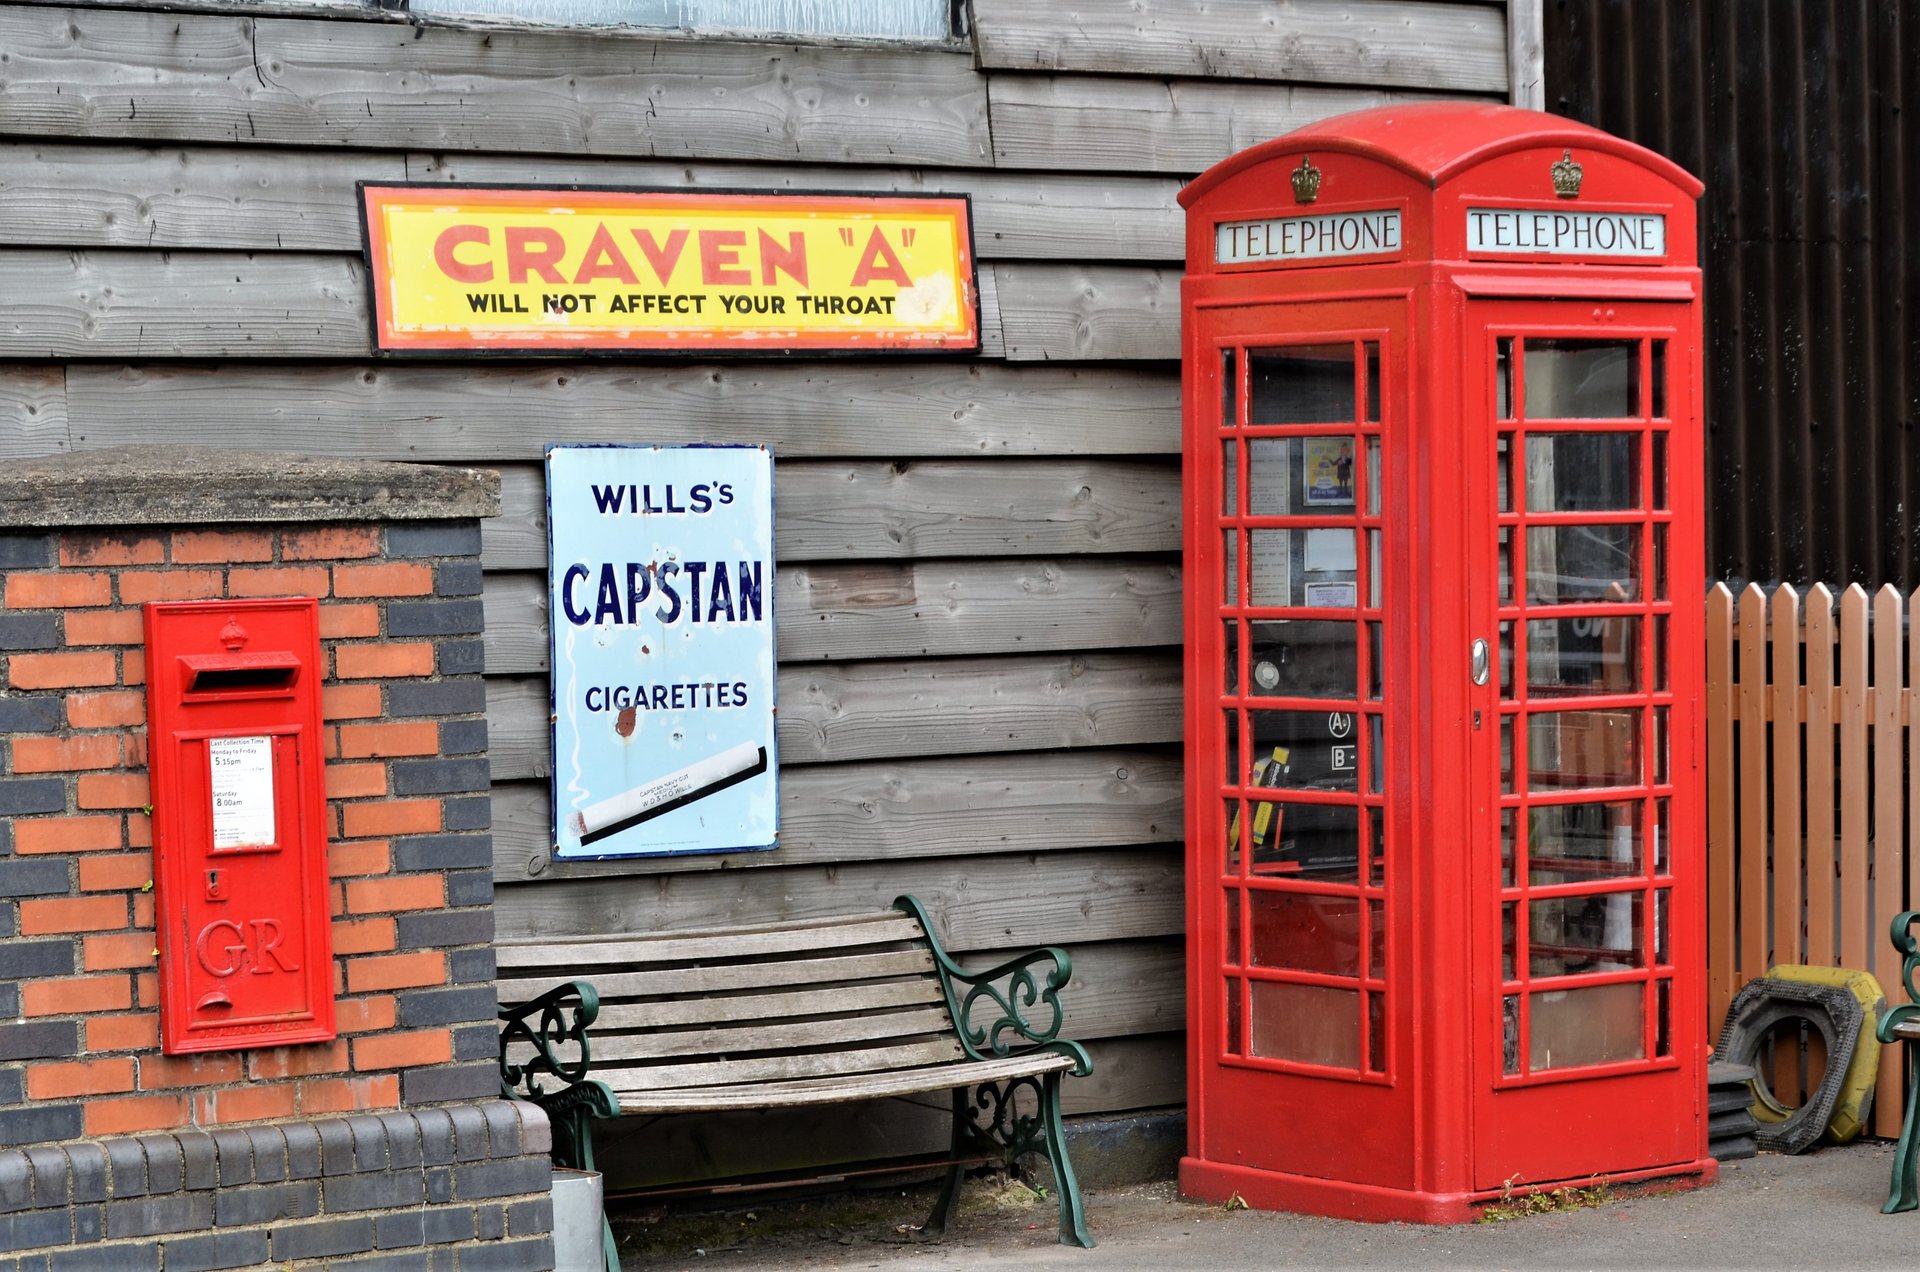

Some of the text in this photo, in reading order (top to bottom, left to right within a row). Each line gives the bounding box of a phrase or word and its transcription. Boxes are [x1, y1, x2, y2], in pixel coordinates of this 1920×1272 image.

[1226, 215, 1398, 258] TELEPHONE
[1471, 213, 1655, 251] TELEPHONE
[433, 221, 916, 289] CRAVEN "A"
[466, 294, 896, 315] WILL NOT AFFECT YOUR THROAT
[591, 480, 734, 514] WILLS'S
[562, 560, 763, 626] CAPSTAN
[585, 681, 748, 712] CIGARETTES
[215, 756, 241, 766] 5.15pm
[216, 797, 243, 807] 8.00am
[639, 773, 689, 798] CAPSTAN NAVY CUT
[196, 917, 300, 978] GR
